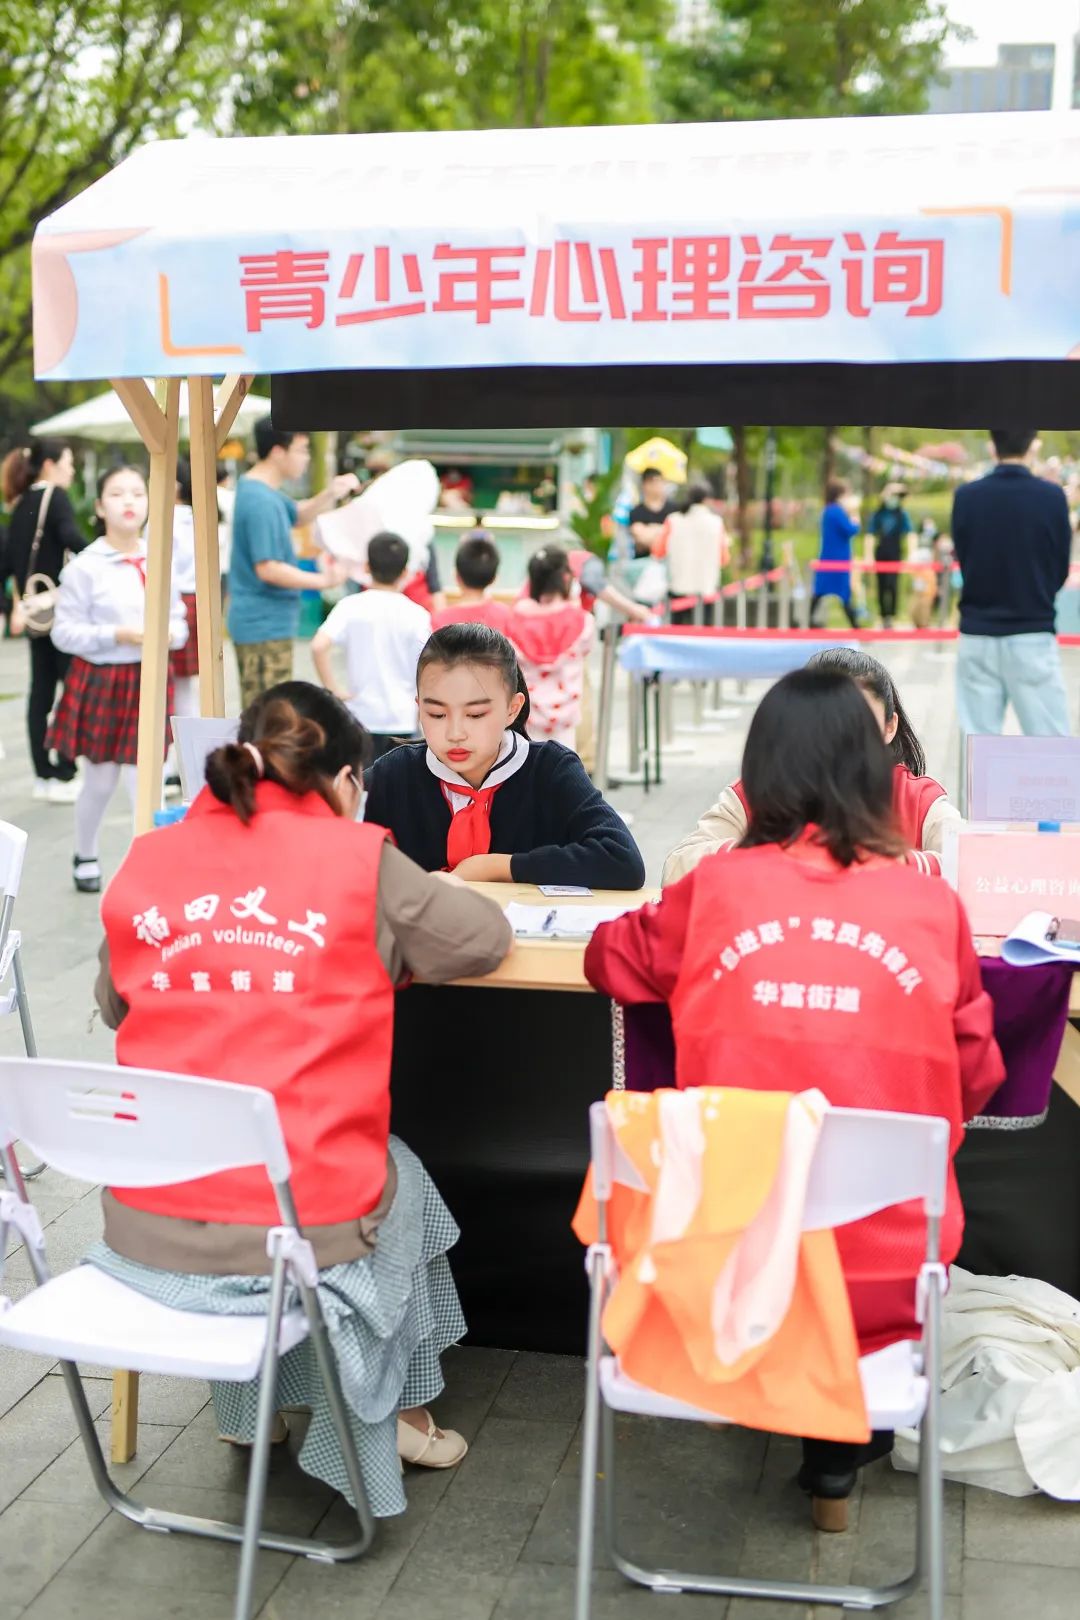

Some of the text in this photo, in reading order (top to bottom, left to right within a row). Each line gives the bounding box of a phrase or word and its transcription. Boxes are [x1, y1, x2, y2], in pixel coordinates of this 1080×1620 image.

[238, 231, 945, 333] 青少年心理咨询
[212, 925, 305, 957] volunteer
[151, 970, 295, 993] 华富街道
[752, 980, 861, 1013] 华富街道
